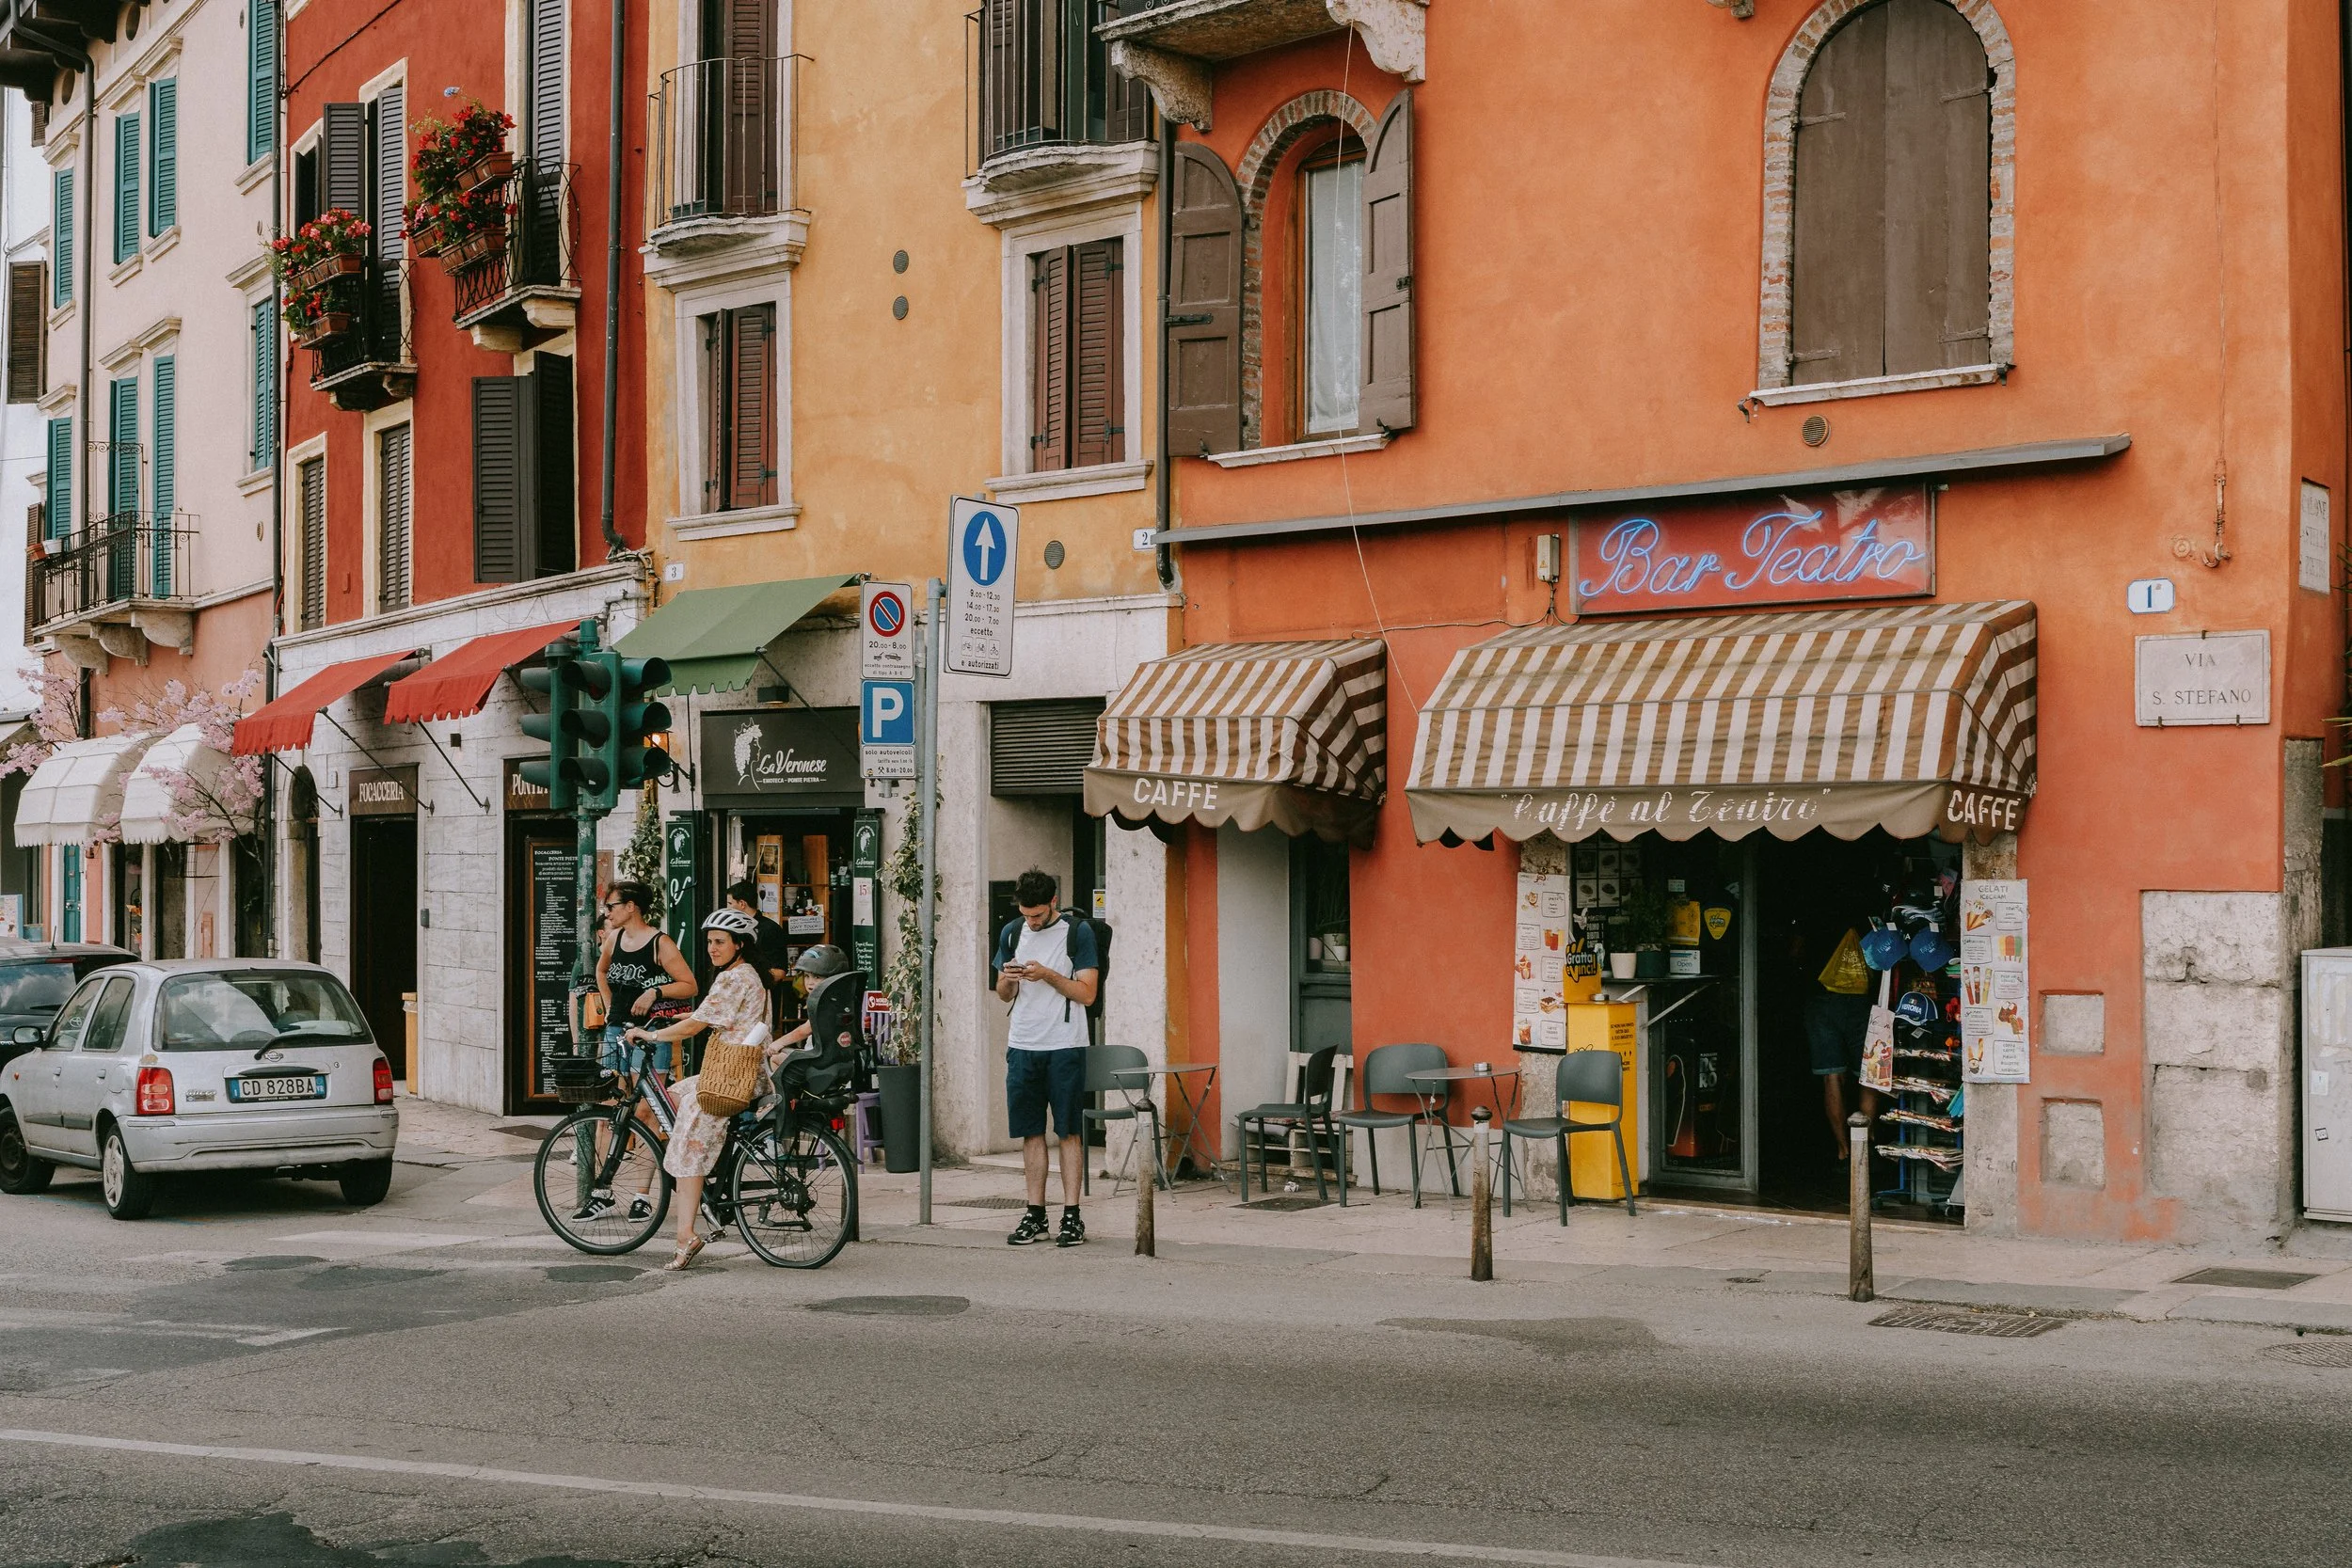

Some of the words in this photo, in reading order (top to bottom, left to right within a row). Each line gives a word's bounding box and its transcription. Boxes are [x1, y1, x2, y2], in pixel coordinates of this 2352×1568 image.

[1142, 531, 1148, 546] 2
[1579, 517, 1721, 597] Bar
[1724, 510, 1926, 591] Teatro
[671, 565, 677, 578] 3
[970, 627, 993, 636] eccetto
[968, 659, 999, 670] autorizzati
[2185, 653, 2217, 667] VIA
[2153, 690, 2166, 705] S.
[2174, 689, 2251, 705] STEFANO
[872, 687, 904, 738] P
[776, 748, 827, 774] Veronese
[358, 780, 405, 802] FOCACCERIA
[1627, 791, 1673, 823] al
[859, 884, 867, 896] 15
[1566, 952, 1593, 965] Gratta
[242, 1081, 262, 1096] CD
[266, 1078, 315, 1095] 828BA
